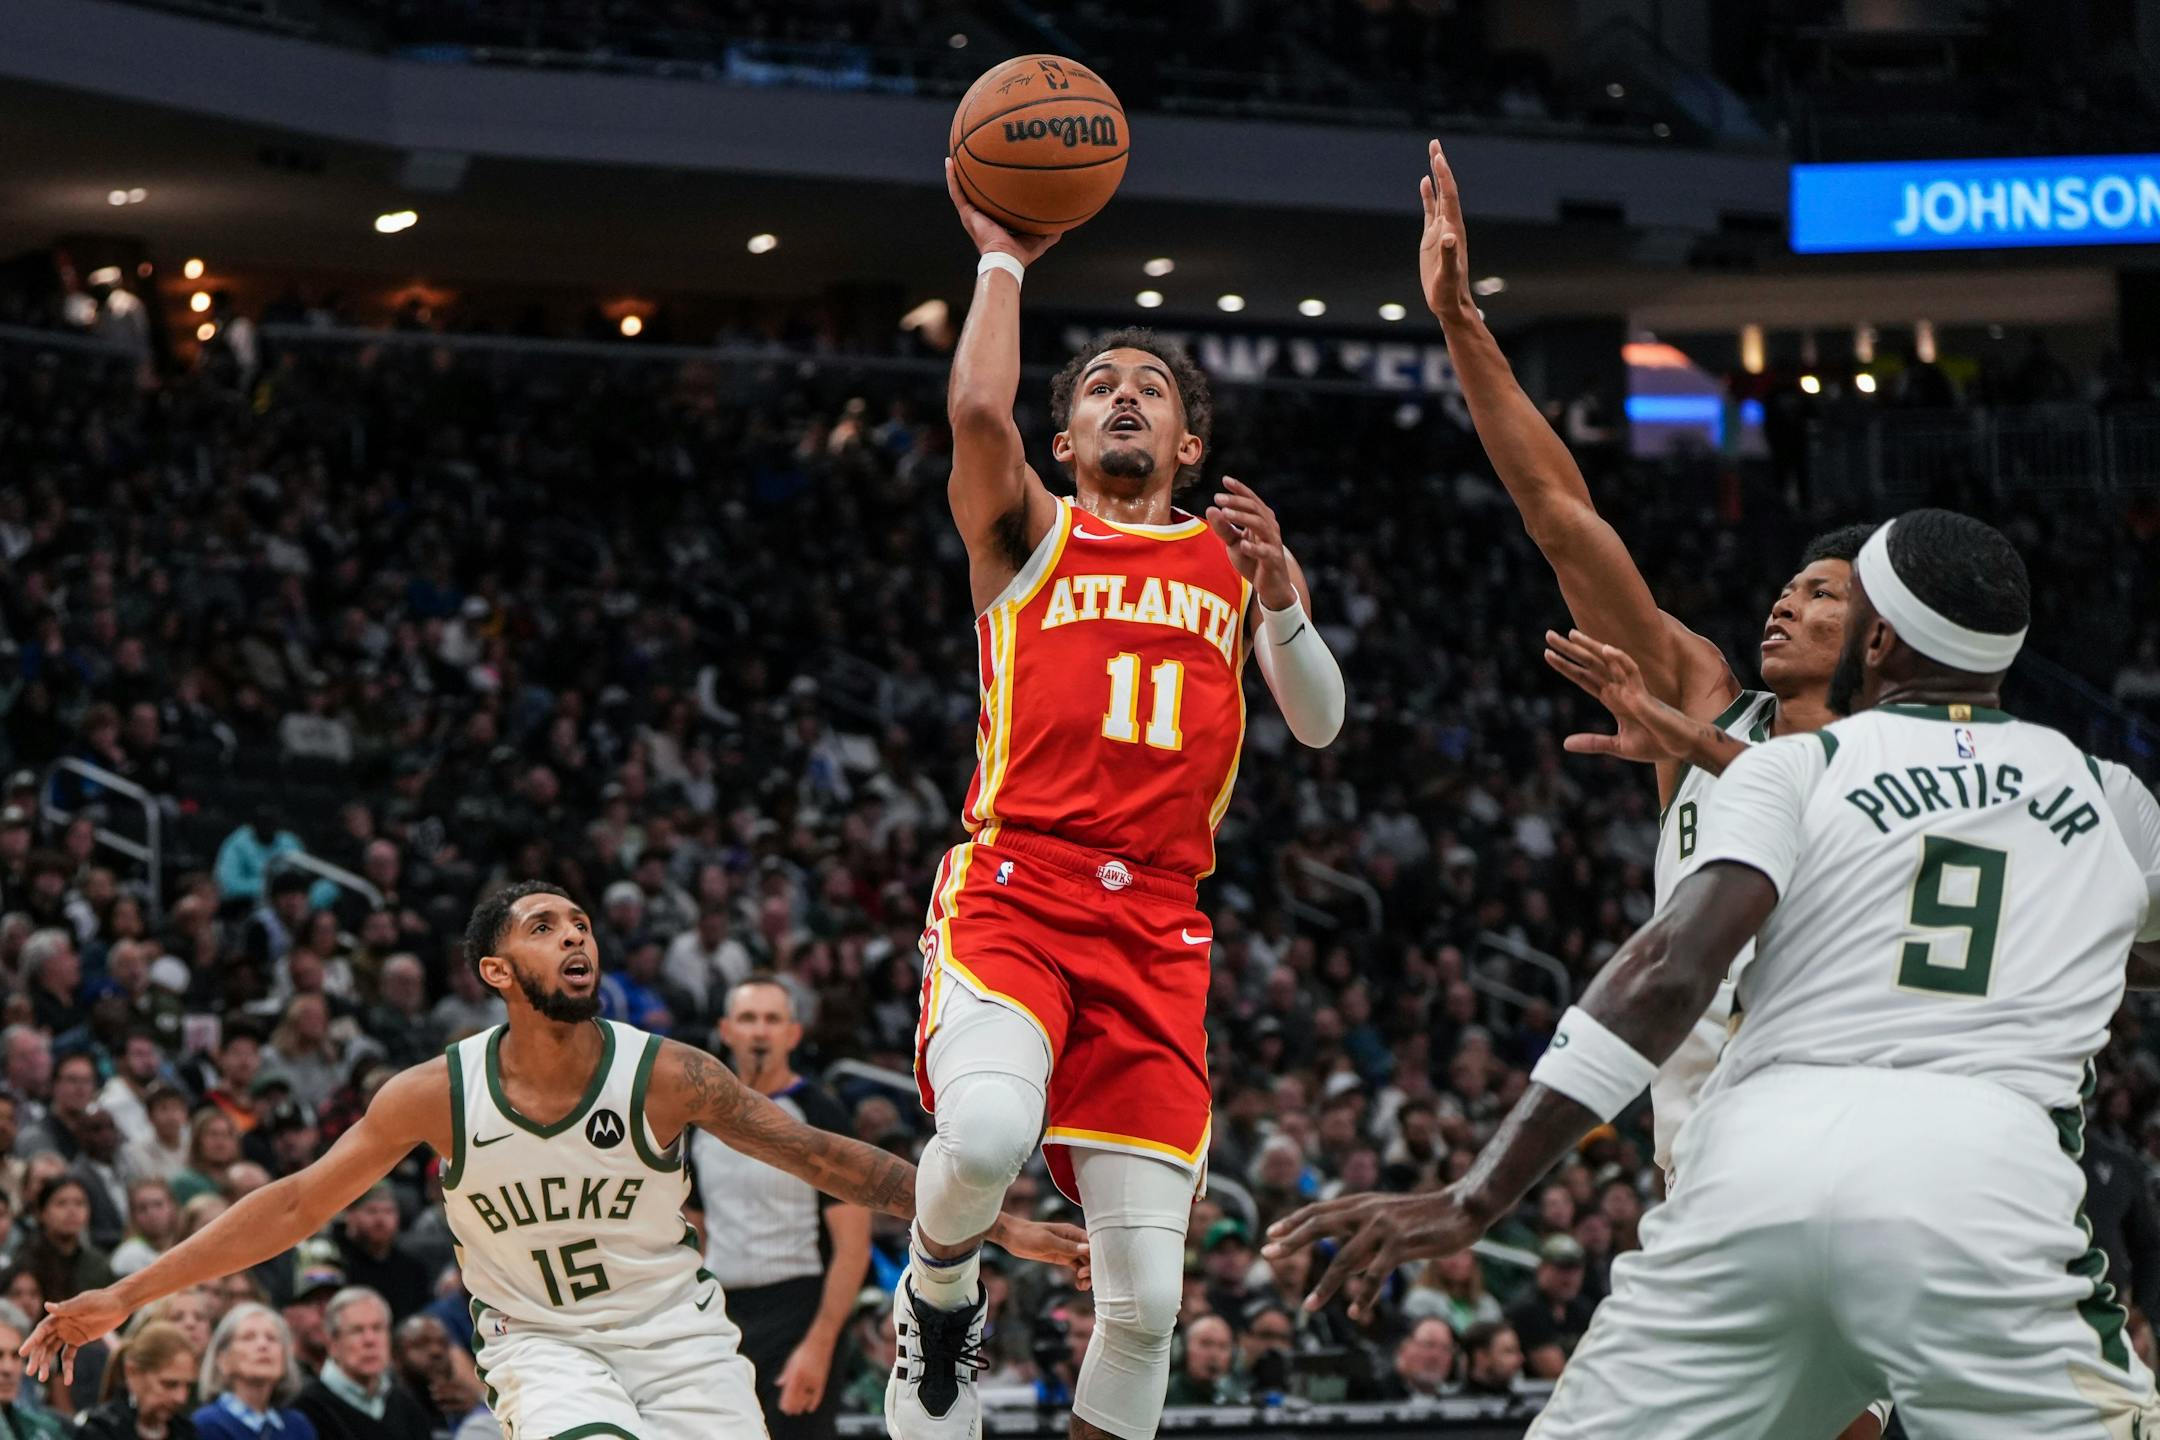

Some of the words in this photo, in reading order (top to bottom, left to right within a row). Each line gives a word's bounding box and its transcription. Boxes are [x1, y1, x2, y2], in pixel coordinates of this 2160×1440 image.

[1003, 115, 1118, 147] Wilson
[1041, 574, 1239, 669] ATLANTA
[1102, 652, 1184, 751] 11
[1845, 763, 2022, 834] PORTIS
[2028, 786, 2100, 846] JR
[1096, 866, 1133, 886] HAWKS
[1896, 832, 2012, 1000] 9
[467, 1177, 644, 1234] BUCKS
[531, 1238, 610, 1307] 15
